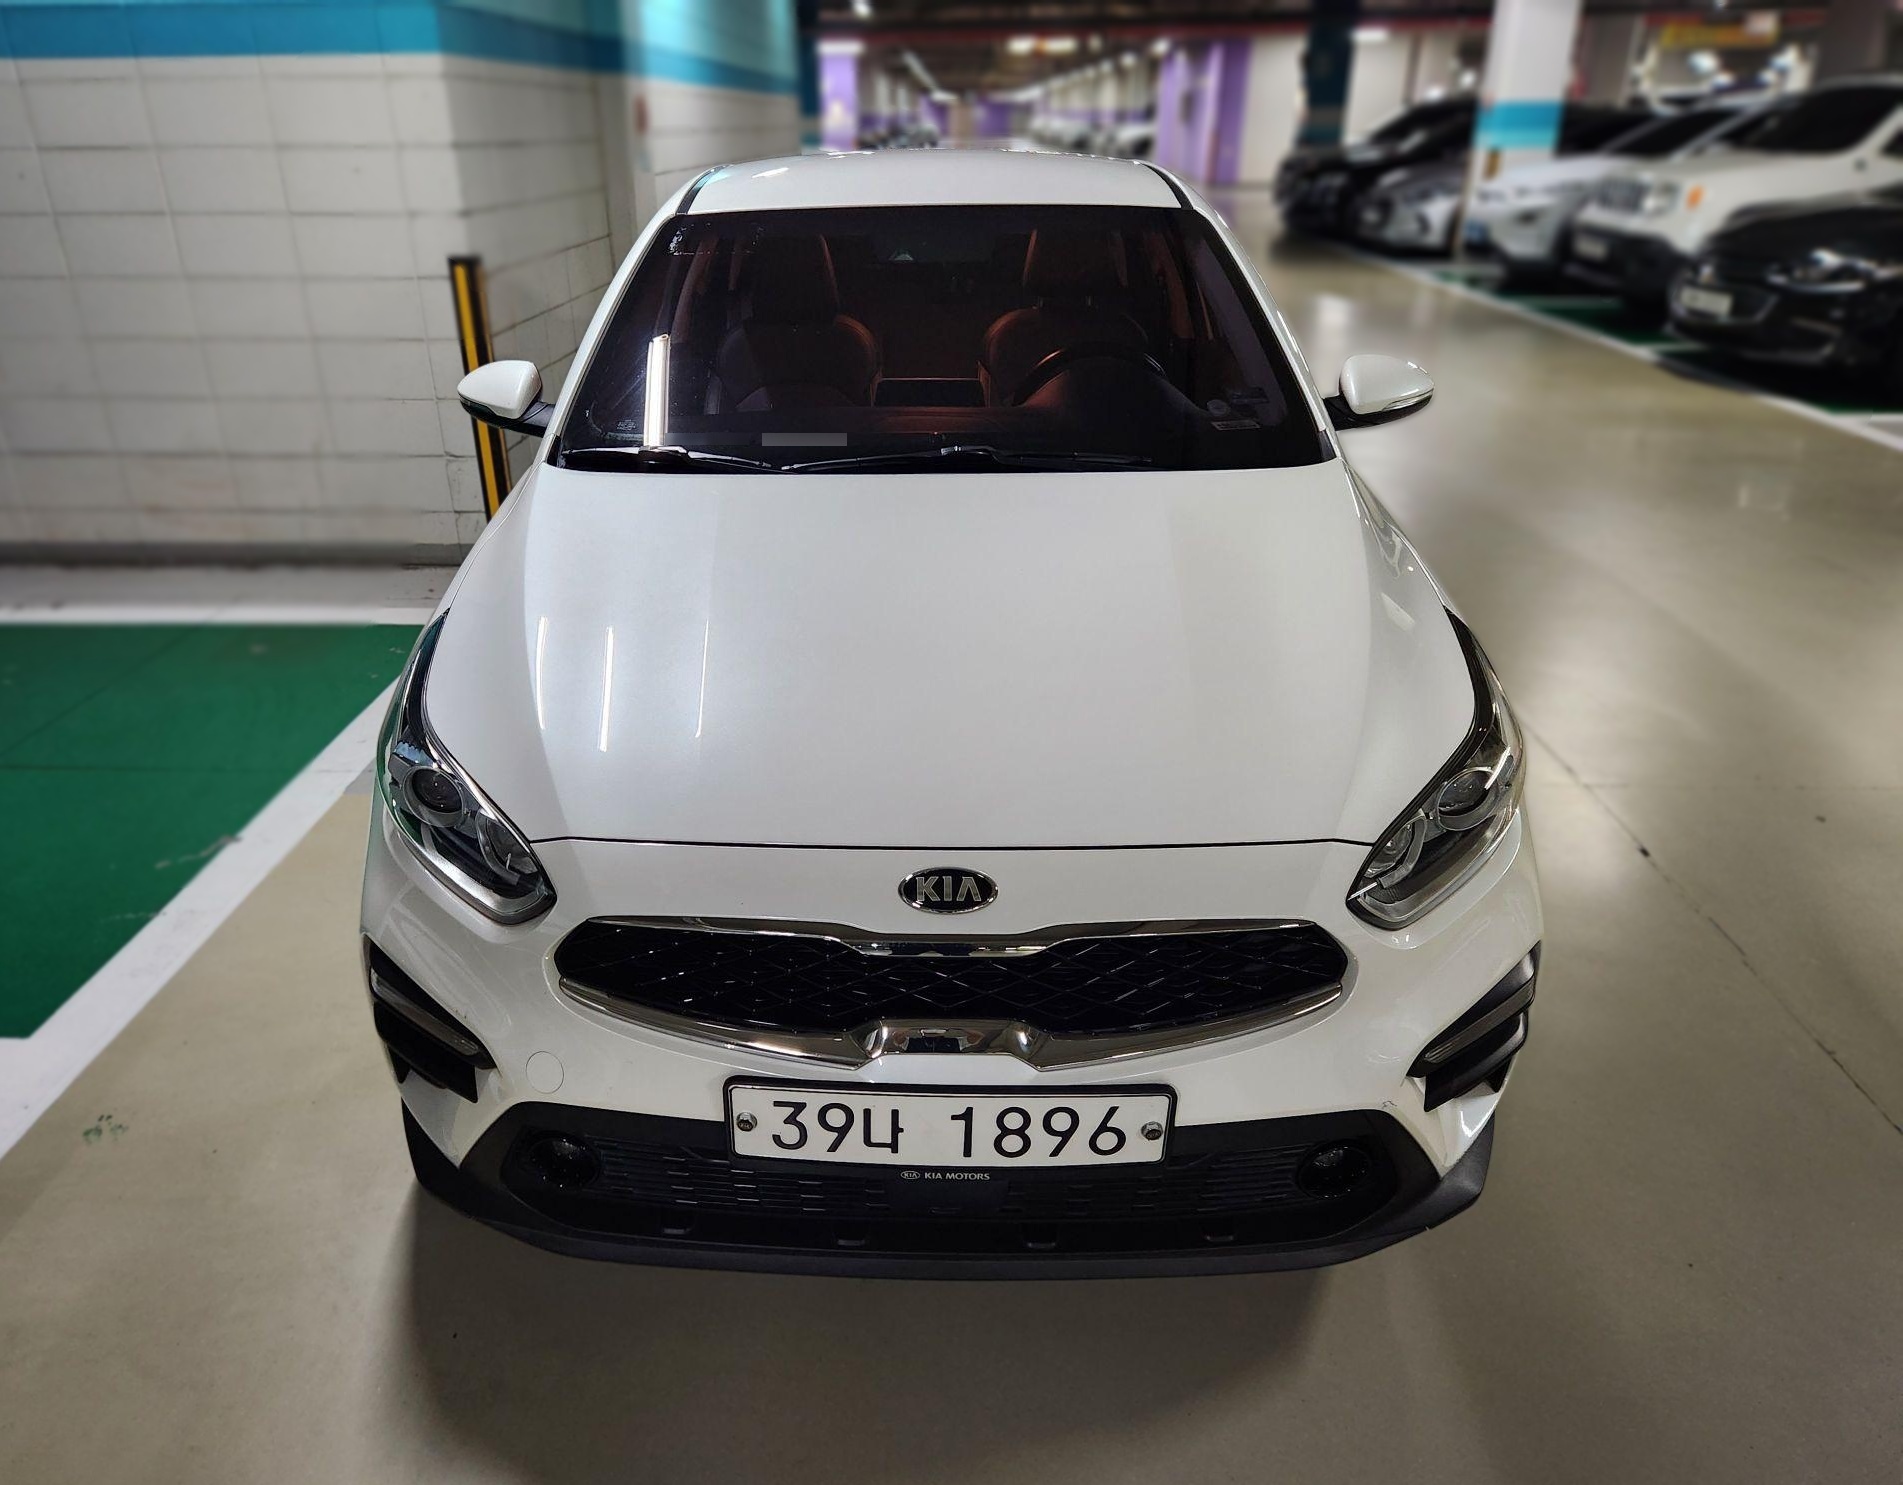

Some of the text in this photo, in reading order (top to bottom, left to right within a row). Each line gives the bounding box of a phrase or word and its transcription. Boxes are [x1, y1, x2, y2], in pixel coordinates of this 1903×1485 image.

[915, 875, 982, 902] KIA
[771, 1100, 1128, 1159] 39나 1896
[924, 1171, 991, 1181] KIA MOTORS
